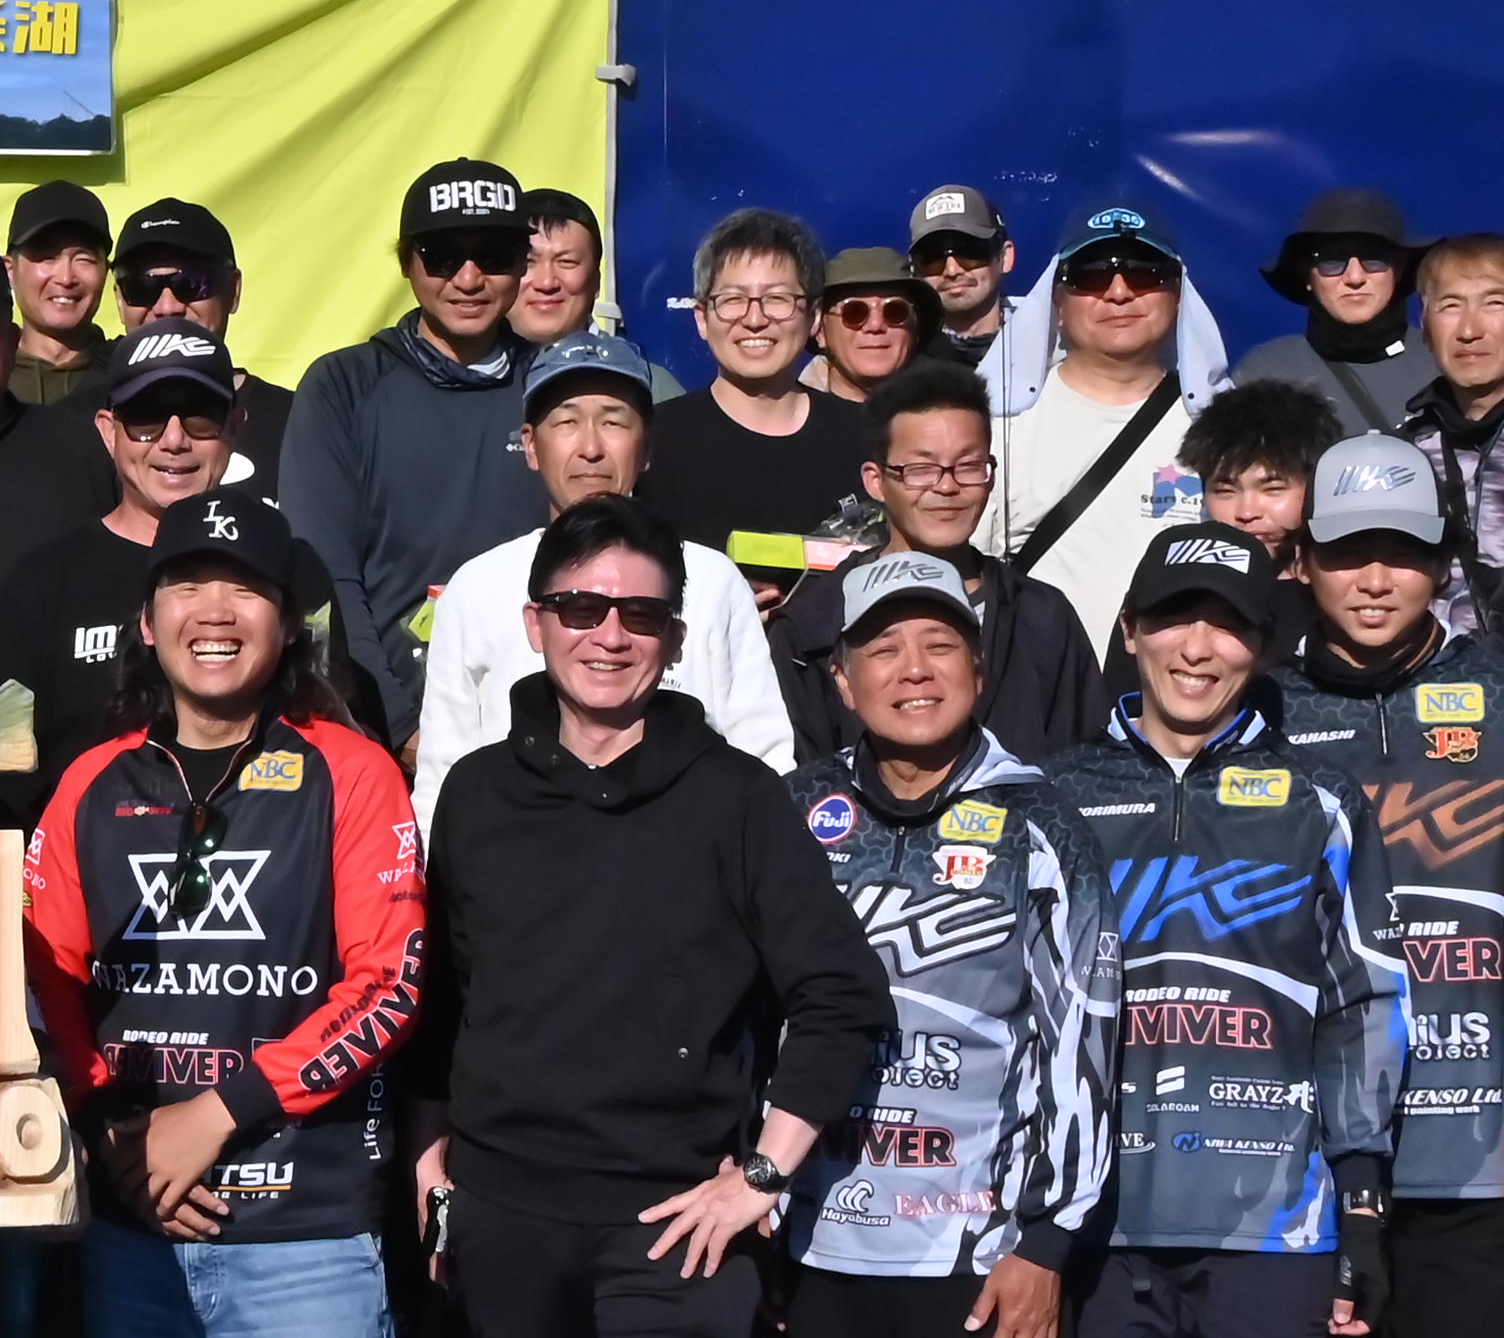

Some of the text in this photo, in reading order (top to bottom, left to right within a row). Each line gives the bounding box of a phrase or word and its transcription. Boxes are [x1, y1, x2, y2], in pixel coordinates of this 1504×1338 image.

[1425, 691, 1477, 713] NBC
[1227, 776, 1283, 799] NBC
[812, 810, 850, 829] Fuji
[947, 807, 999, 833] NBC
[1407, 920, 1460, 937] RIDE
[1183, 986, 1232, 1003] RIDE
[169, 1031, 210, 1046] RIDE
[1208, 1082, 1284, 1104] GRAYZ
[821, 1208, 891, 1226] Hayabusa
